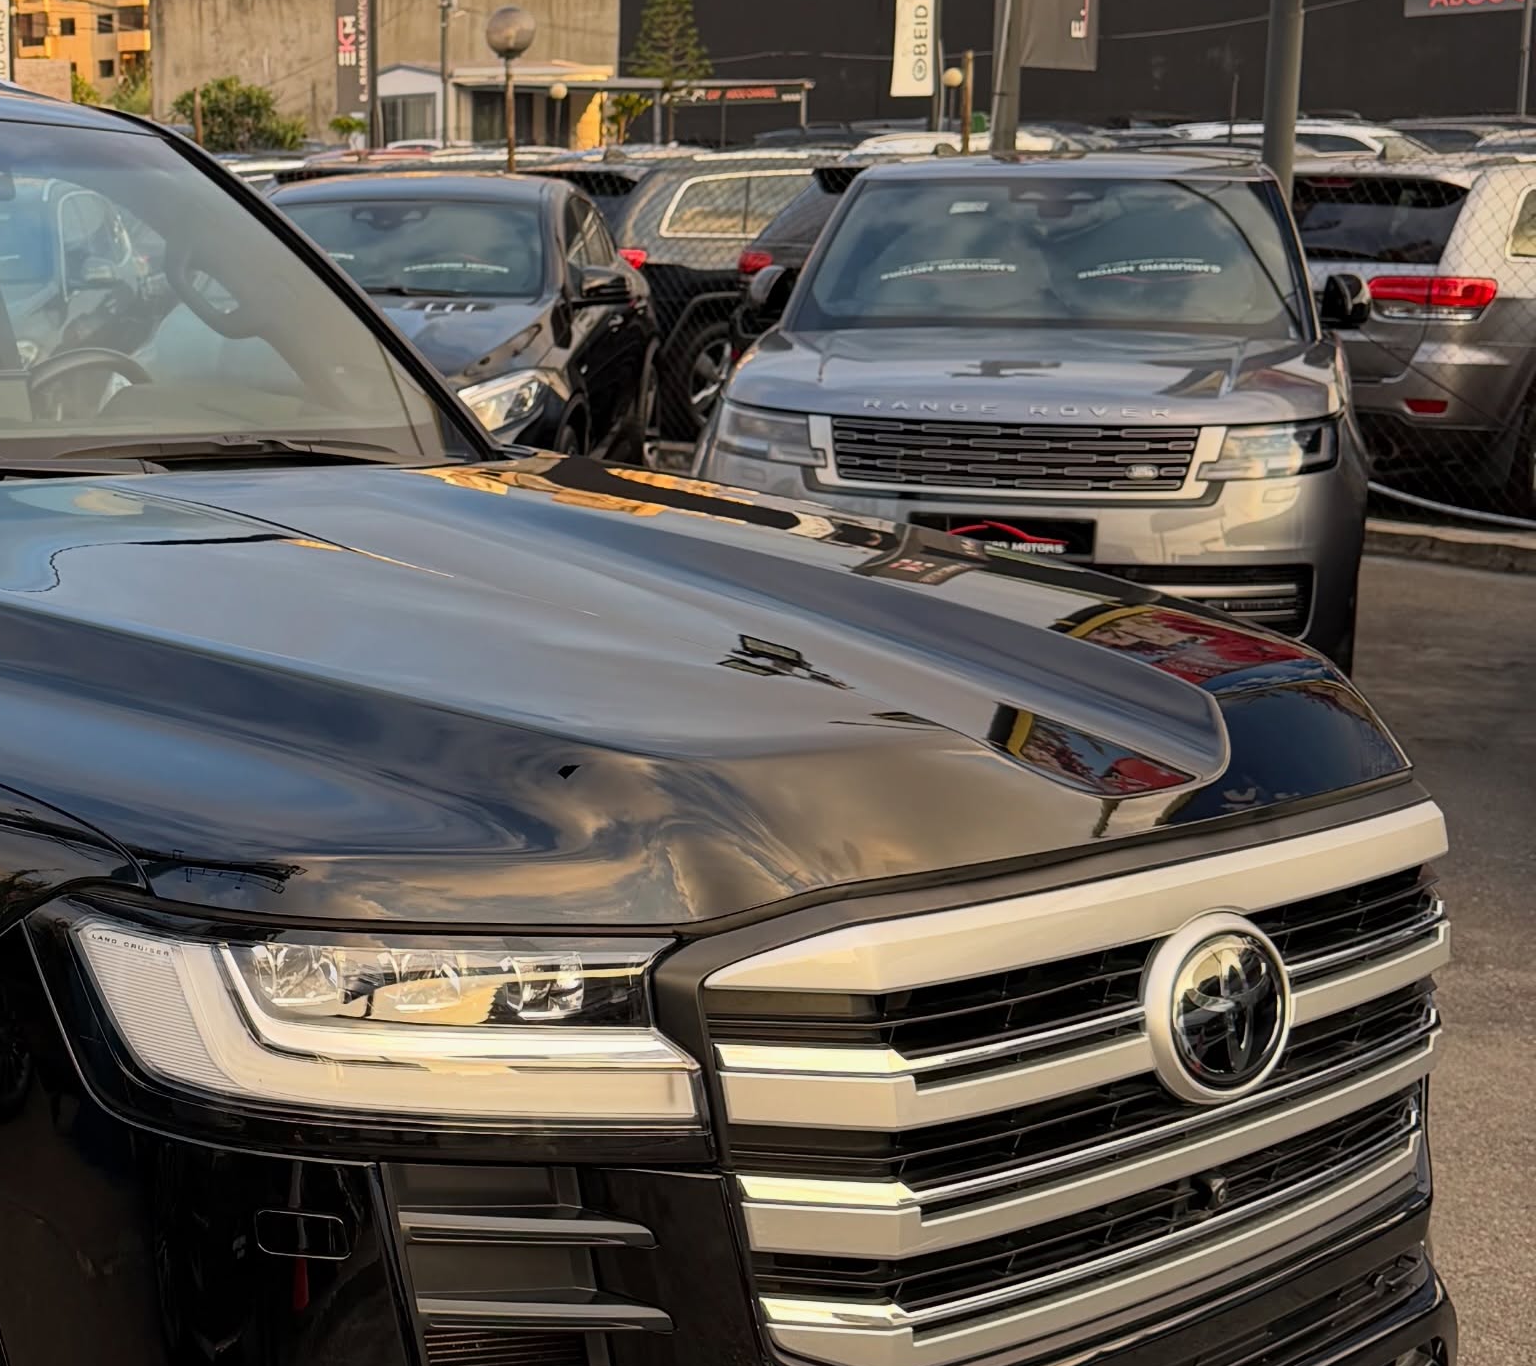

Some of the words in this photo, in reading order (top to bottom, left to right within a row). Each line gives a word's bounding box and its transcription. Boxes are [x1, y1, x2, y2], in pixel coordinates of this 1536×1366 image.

[863, 399, 1001, 415] RANGE
[1029, 404, 1171, 420] ROVER
[1011, 541, 1065, 555] MOTORS
[91, 934, 117, 945] LAND
[123, 941, 170, 957] CRUISER
